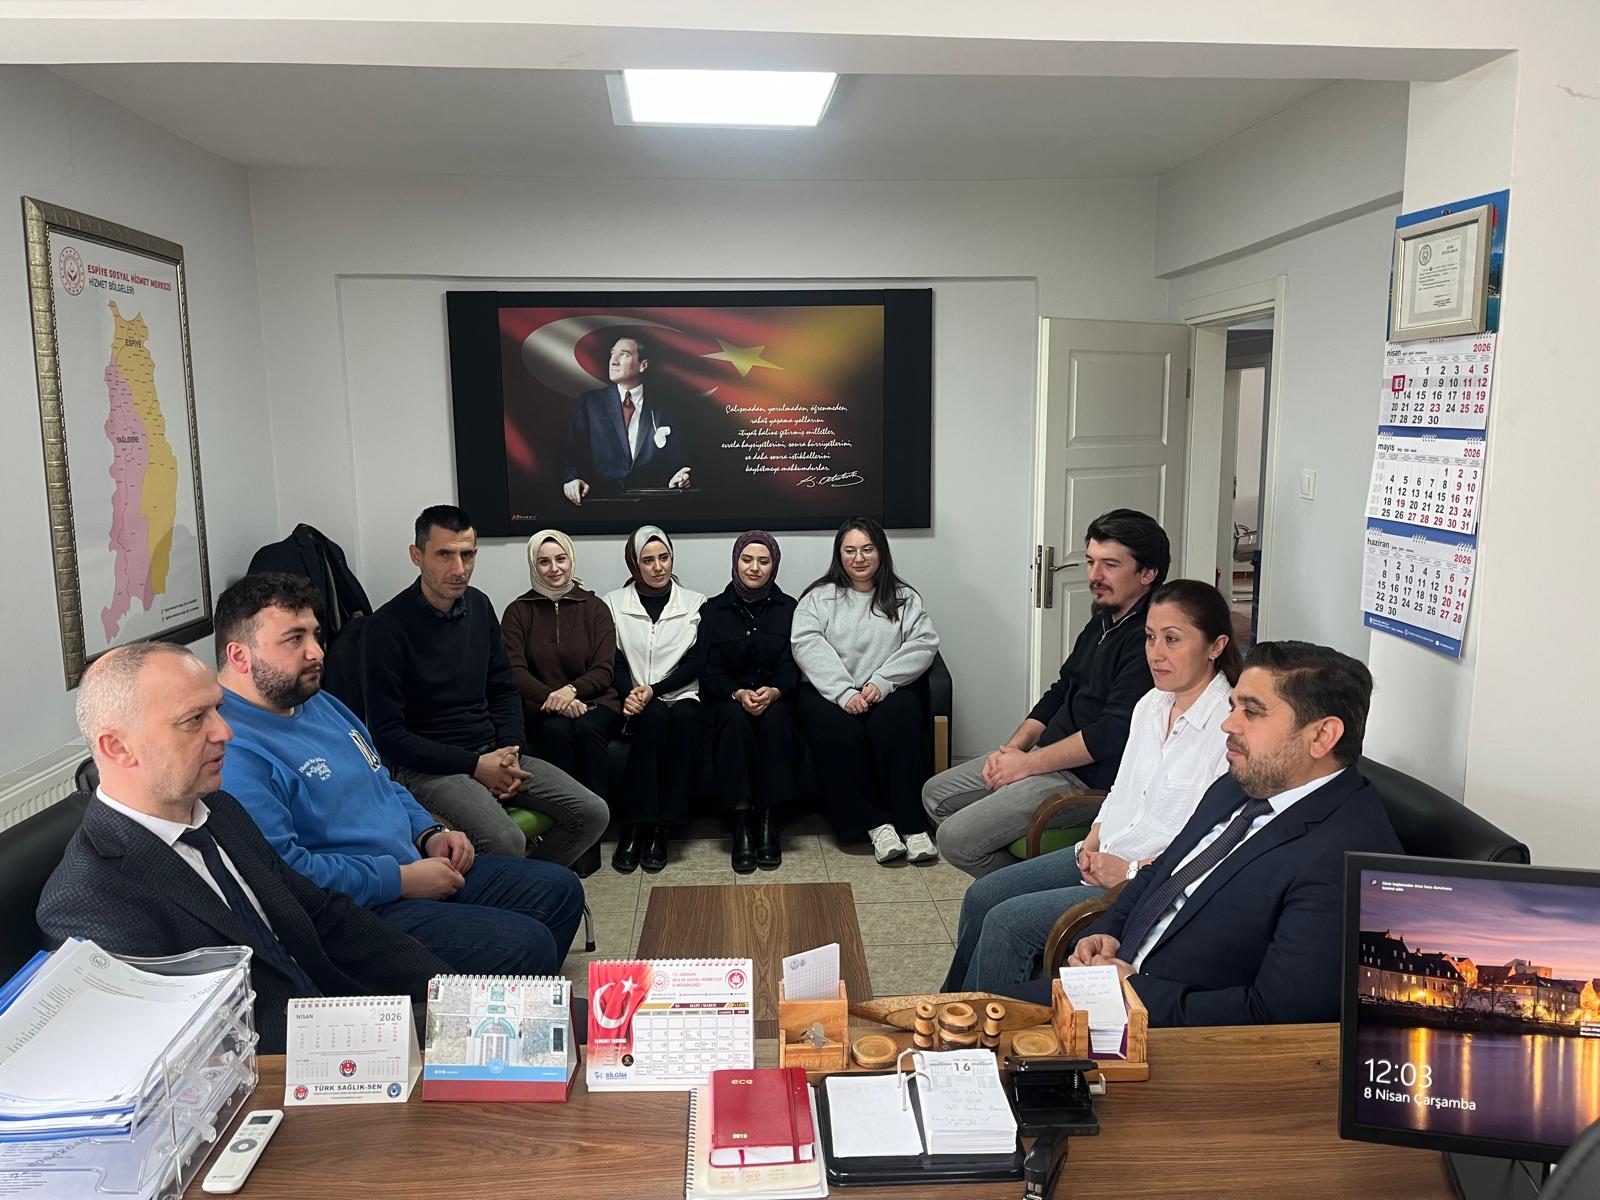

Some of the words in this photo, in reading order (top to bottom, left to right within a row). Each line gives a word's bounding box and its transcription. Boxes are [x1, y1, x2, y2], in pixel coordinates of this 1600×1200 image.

[87, 265, 108, 277] ESPİYE
[109, 269, 130, 281] SOSYAL
[131, 273, 149, 285] HİZMET
[150, 280, 171, 291] MERKEZİ
[89, 277, 108, 288] HİZMET
[108, 281, 135, 295] BÖLGELERİ
[125, 338, 142, 348] ESPİYE
[1473, 343, 1491, 352] 2026
[1425, 366, 1429, 375] 1
[1440, 366, 1445, 375] 2
[1455, 366, 1459, 374] 3
[1469, 365, 1474, 374] 4
[1483, 365, 1489, 374] 5
[1397, 379, 1401, 387] 6
[1408, 379, 1413, 387] 7
[1423, 379, 1428, 387] 8
[1438, 379, 1444, 387] 9
[1450, 378, 1458, 387] 10
[1463, 378, 1472, 387] 11
[1478, 378, 1487, 387] 12
[1393, 391, 1399, 399] 13
[1403, 391, 1411, 399] 14
[1417, 391, 1426, 399] 15
[1432, 391, 1442, 399] 16
[1448, 391, 1457, 399] 17
[1462, 391, 1471, 400] 18
[1476, 391, 1486, 400] 19
[1392, 403, 1398, 411] 20
[1401, 403, 1409, 411] 21
[1414, 403, 1424, 412] 22
[1430, 403, 1440, 412] 23
[1446, 404, 1456, 412] 24
[1460, 404, 1469, 412] 25
[1474, 404, 1484, 413] 26
[1390, 415, 1396, 423] 27
[1400, 415, 1408, 423] 28
[1412, 415, 1423, 424] 29
[1428, 416, 1439, 424] 30
[1464, 448, 1480, 458] 2026
[1445, 468, 1448, 476] 1
[1458, 469, 1463, 478] 2
[1473, 471, 1477, 479] 3
[1403, 476, 1408, 484] 5
[1417, 478, 1421, 486] 6
[1430, 479, 1435, 487] 7
[1443, 480, 1447, 489] 8
[1457, 482, 1461, 490] 9
[1467, 483, 1475, 492] 10
[1385, 486, 1392, 494] 11
[1398, 487, 1406, 496] 12
[1412, 489, 1419, 497] 13
[1425, 490, 1432, 499] 14
[1438, 492, 1445, 501] 15
[1451, 494, 1459, 503] 16
[1465, 496, 1473, 505] 17
[1384, 497, 1391, 505] 18
[1396, 499, 1405, 507] 19
[1410, 501, 1418, 509] 20
[1422, 502, 1430, 511] 21
[1435, 504, 1444, 513] 22
[1449, 506, 1458, 516] 23
[1463, 508, 1471, 518] 24
[1382, 508, 1390, 517] 25
[1395, 510, 1403, 519] 26
[1408, 513, 1416, 521] 27
[1420, 514, 1429, 523] 28
[1434, 517, 1443, 526] 29
[1447, 519, 1456, 528] 30
[1461, 521, 1469, 530] 31
[1368, 538, 1389, 548] haziran
[1454, 554, 1471, 564] 2026
[1397, 562, 1401, 570] 2
[1423, 568, 1428, 576] 4
[1436, 570, 1440, 579] 5
[1450, 573, 1455, 582] 6
[1465, 577, 1469, 585] 7
[1383, 570, 1386, 578] 8
[1396, 573, 1400, 581] 9
[1405, 575, 1413, 584] 10
[1418, 579, 1425, 587] 11
[1431, 582, 1439, 591] 12
[1444, 585, 1453, 594] 13
[1458, 588, 1467, 598] 14
[1378, 581, 1386, 589] 15
[1391, 584, 1399, 592] 16
[1404, 587, 1411, 596] 17
[1416, 590, 1424, 599] 18
[1429, 594, 1437, 603] 19
[1442, 597, 1451, 607] 20
[1455, 601, 1464, 611] 21
[1375, 603, 1383, 612] 29
[1388, 606, 1396, 616] 30
[1376, 592, 1385, 601] 22
[1389, 595, 1397, 604] 23
[1402, 599, 1410, 608] 24
[1414, 602, 1423, 611] 25
[1427, 606, 1436, 615] 26
[1440, 610, 1449, 619] 27
[1453, 613, 1462, 623] 28
[380, 1013, 402, 1021] 2026
[954, 1063, 971, 1071] 16
[1365, 1058, 1433, 1088] 12:03
[1364, 1087, 1372, 1099] 8
[1376, 1088, 1410, 1103] Nisan
[1414, 1093, 1476, 1111] Çarşamba
